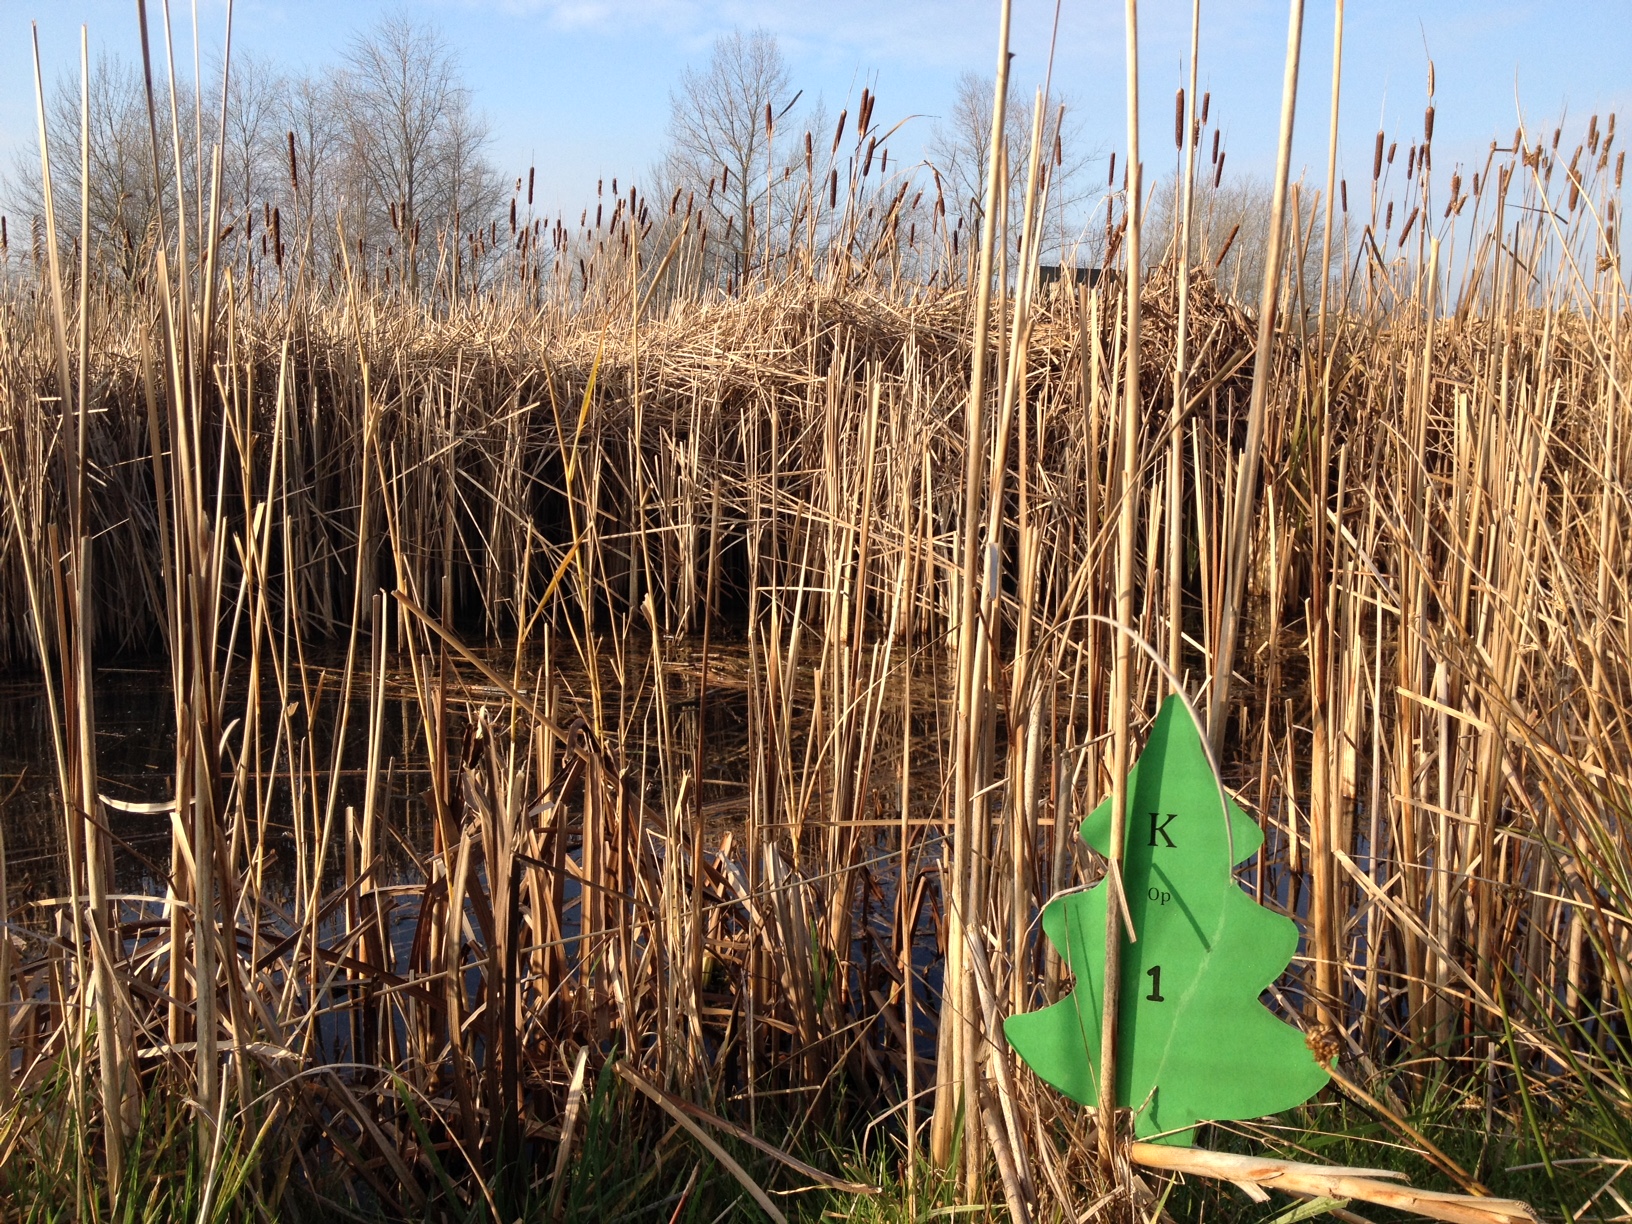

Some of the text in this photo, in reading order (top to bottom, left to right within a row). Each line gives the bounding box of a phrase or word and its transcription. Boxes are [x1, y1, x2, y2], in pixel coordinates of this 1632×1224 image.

[1147, 812, 1178, 848] K
[1148, 887, 1171, 905] Op
[1146, 965, 1165, 1003] 1
